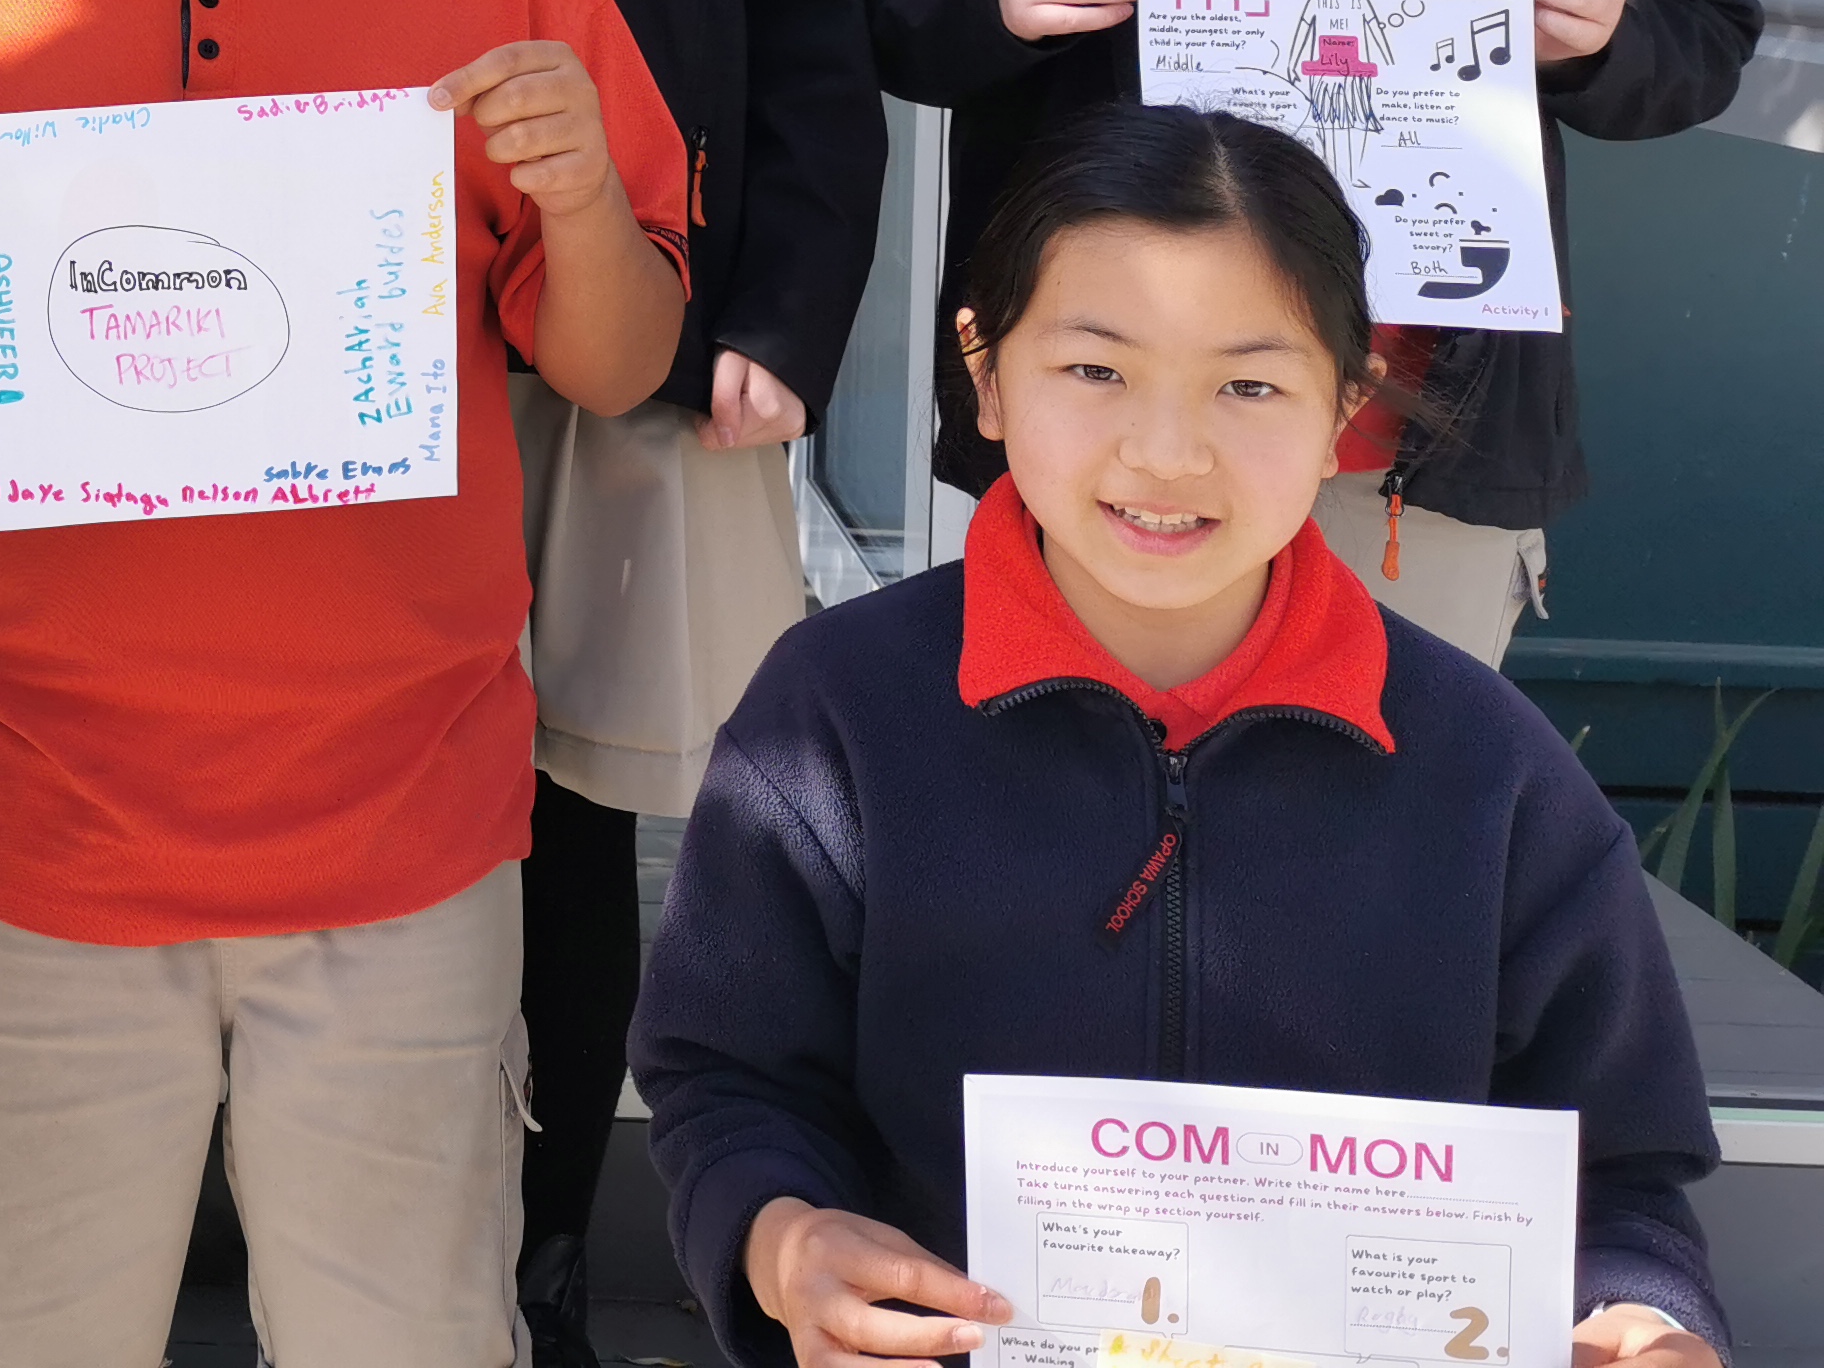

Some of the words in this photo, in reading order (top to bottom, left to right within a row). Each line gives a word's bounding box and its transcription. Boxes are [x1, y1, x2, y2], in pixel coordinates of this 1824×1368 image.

[1329, 17, 1349, 31] ME!
[1156, 54, 1203, 72] Middle
[1320, 54, 1349, 76] Lily
[70, 260, 247, 294] InCommon
[1411, 261, 1448, 274] Both
[80, 304, 224, 340] TAMARIKI
[1482, 304, 1539, 319] Activity
[1139, 834, 1176, 881] OPAWA
[1106, 880, 1148, 932] SCHOOL
[1091, 1118, 1229, 1165] COM
[1260, 1142, 1279, 1156] IN
[1310, 1134, 1453, 1183] MON
[1016, 1194, 1052, 1211] filling
[1055, 1200, 1068, 1208] in
[1071, 1198, 1093, 1210] the
[1098, 1203, 1131, 1218] wrap
[1134, 1205, 1151, 1219] up
[1151, 1207, 1201, 1222] section
[1205, 1211, 1265, 1223] yourself.
[1041, 1221, 1089, 1235] What's
[1092, 1228, 1123, 1239] your
[1042, 1238, 1104, 1253] favourite
[1109, 1245, 1180, 1261] takeaway?
[1351, 1248, 1388, 1261] What
[1392, 1252, 1403, 1263] is
[1406, 1256, 1439, 1267] your
[1351, 1266, 1416, 1280] favourite
[1420, 1273, 1457, 1286] sport
[1462, 1274, 1477, 1284] to
[1141, 1277, 1179, 1325] 1.
[1350, 1284, 1393, 1295] watch
[1396, 1289, 1413, 1297] or
[1416, 1288, 1453, 1303] play?
[1444, 1302, 1510, 1364] 2.
[1025, 1354, 1074, 1368] Walking
